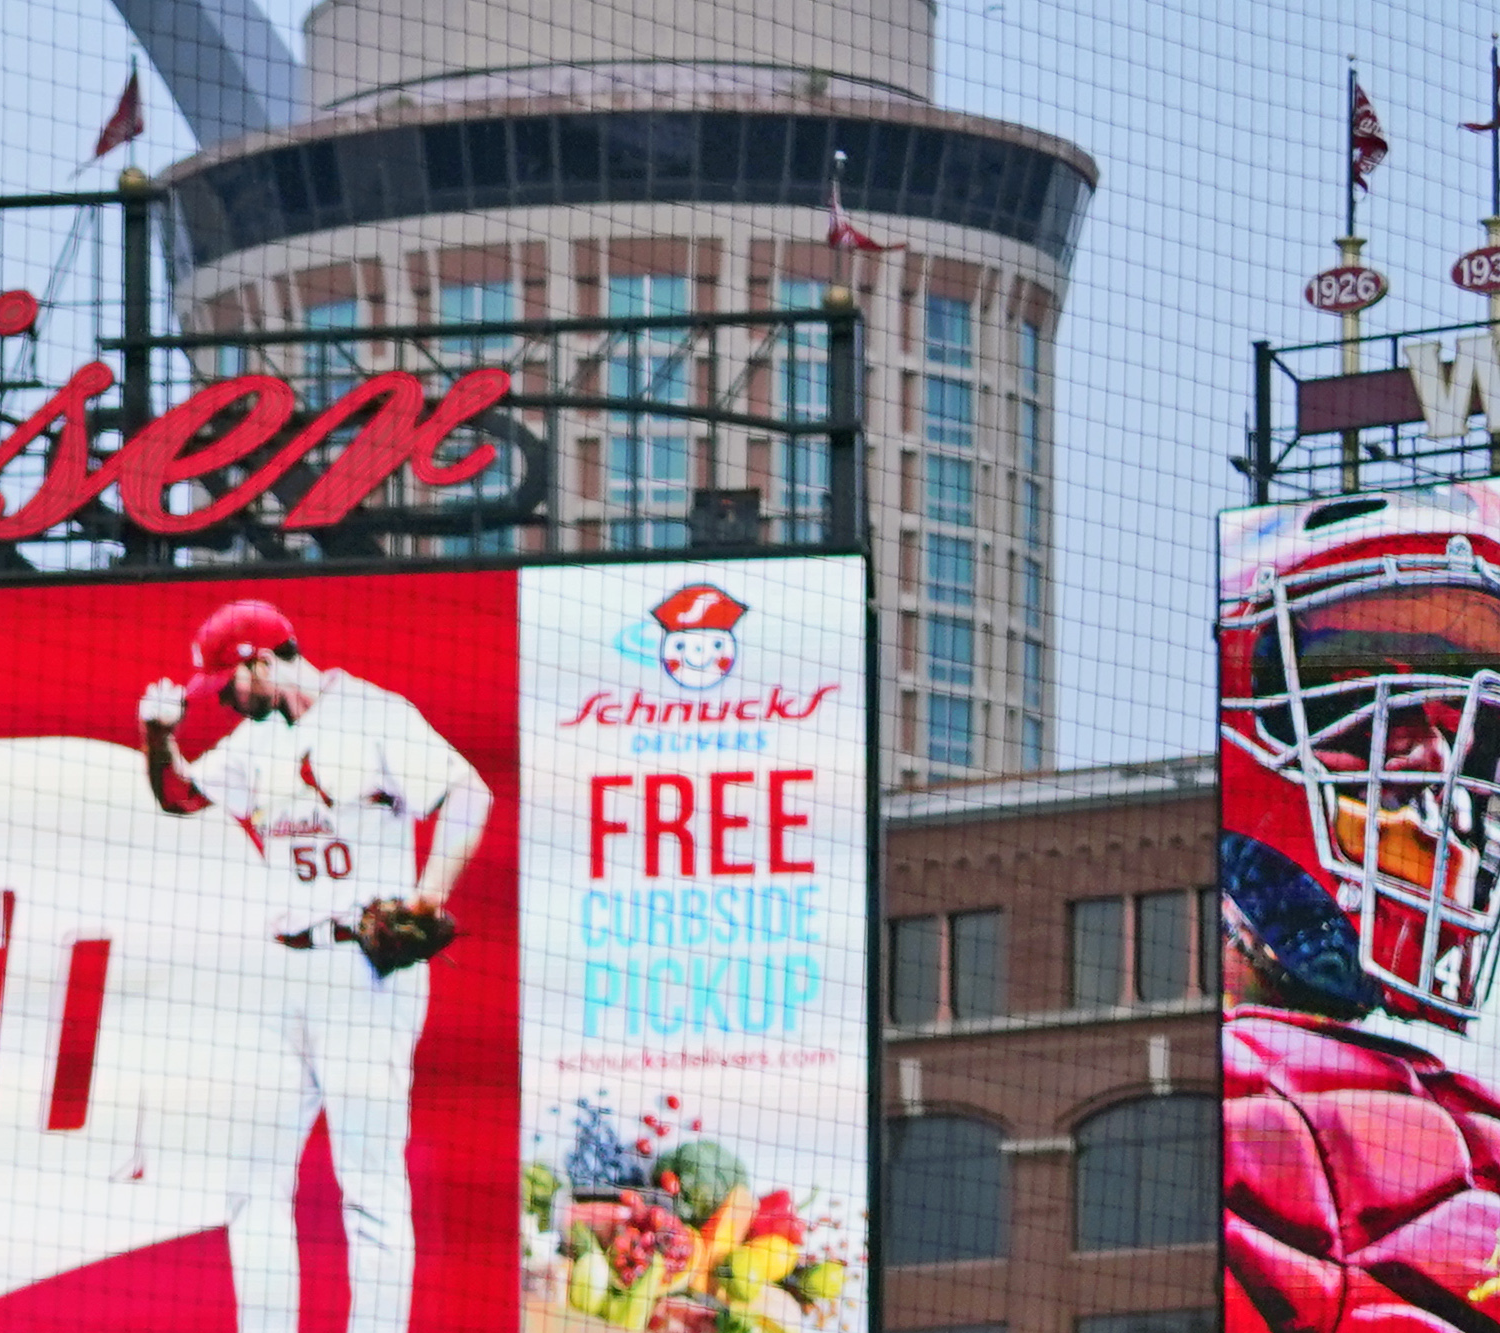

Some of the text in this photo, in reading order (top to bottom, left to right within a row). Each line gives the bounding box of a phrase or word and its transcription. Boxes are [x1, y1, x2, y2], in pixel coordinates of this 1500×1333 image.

[1308, 273, 1377, 307] 1926
[1404, 330, 1500, 438] W
[558, 683, 841, 730] Schnucks
[630, 730, 768, 754] DELIVERS
[588, 768, 816, 880] FREE
[292, 840, 352, 884] 50
[580, 884, 822, 948] CURBSIDE
[582, 953, 822, 1040] PICKUP
